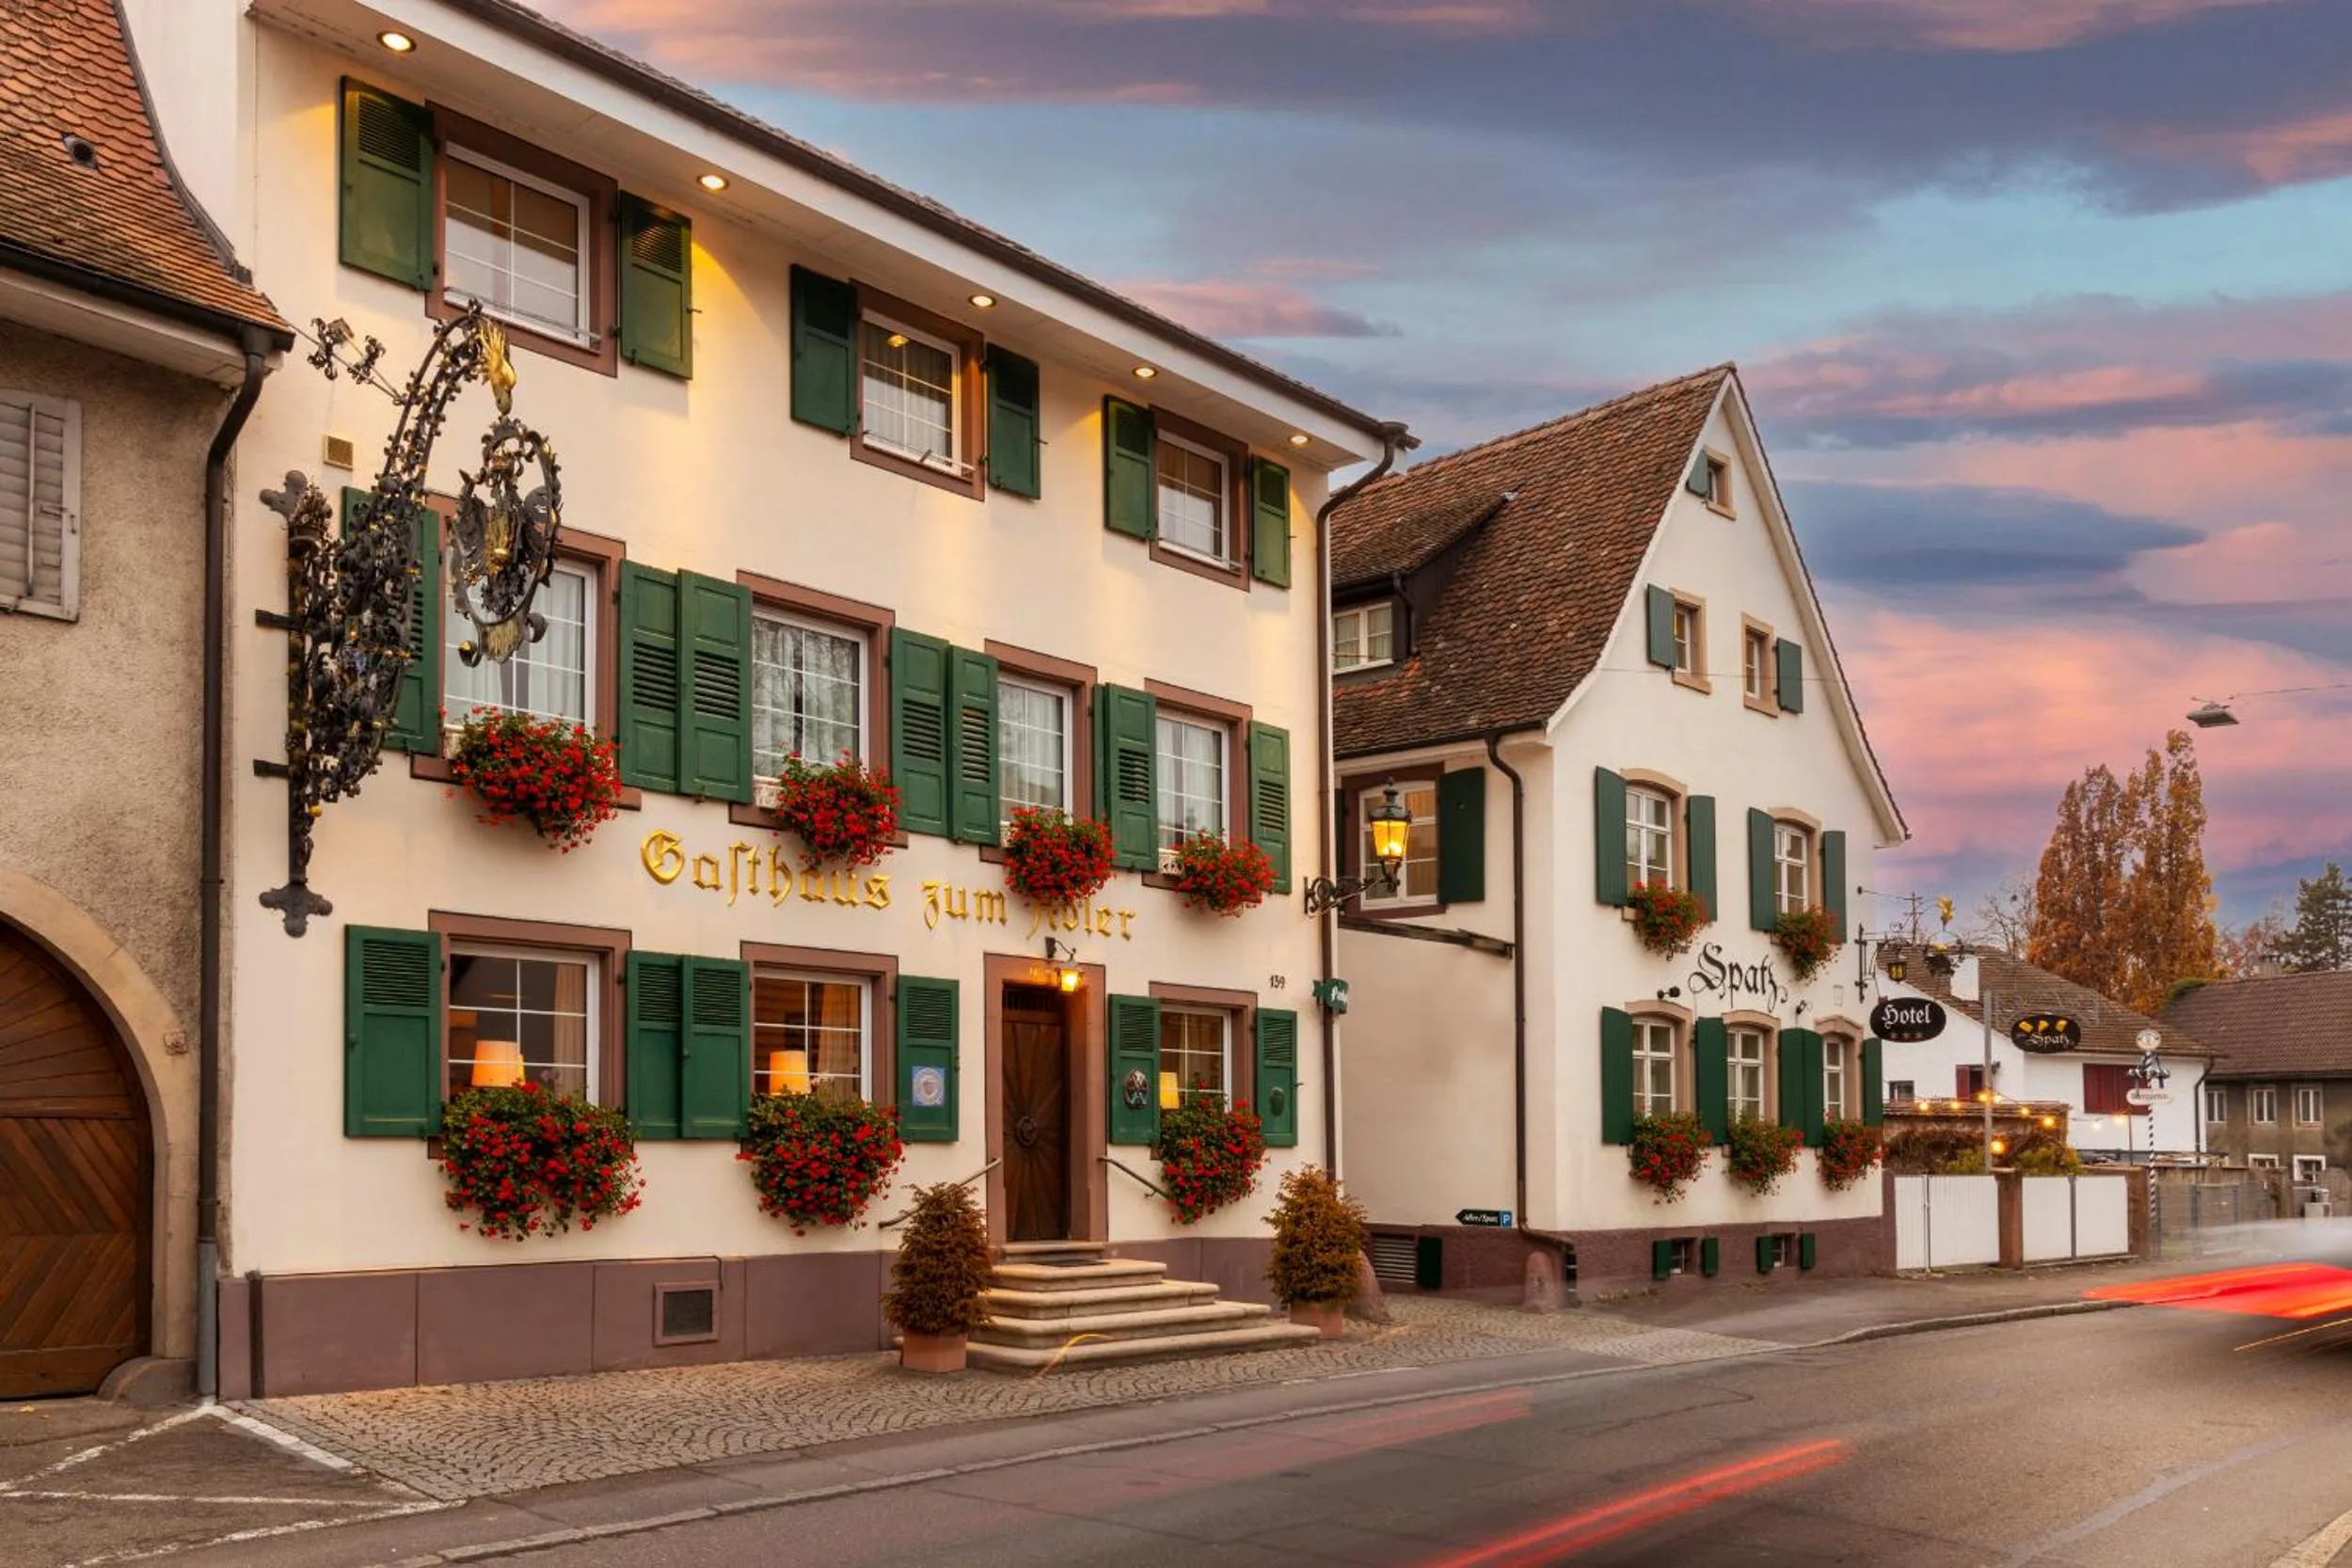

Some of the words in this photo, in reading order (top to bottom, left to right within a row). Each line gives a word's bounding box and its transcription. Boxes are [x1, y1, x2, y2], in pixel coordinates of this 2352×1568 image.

[919, 880, 1008, 930] zum
[1688, 942, 1788, 1013] Spatz
[1882, 1003, 1931, 1030] Hotel
